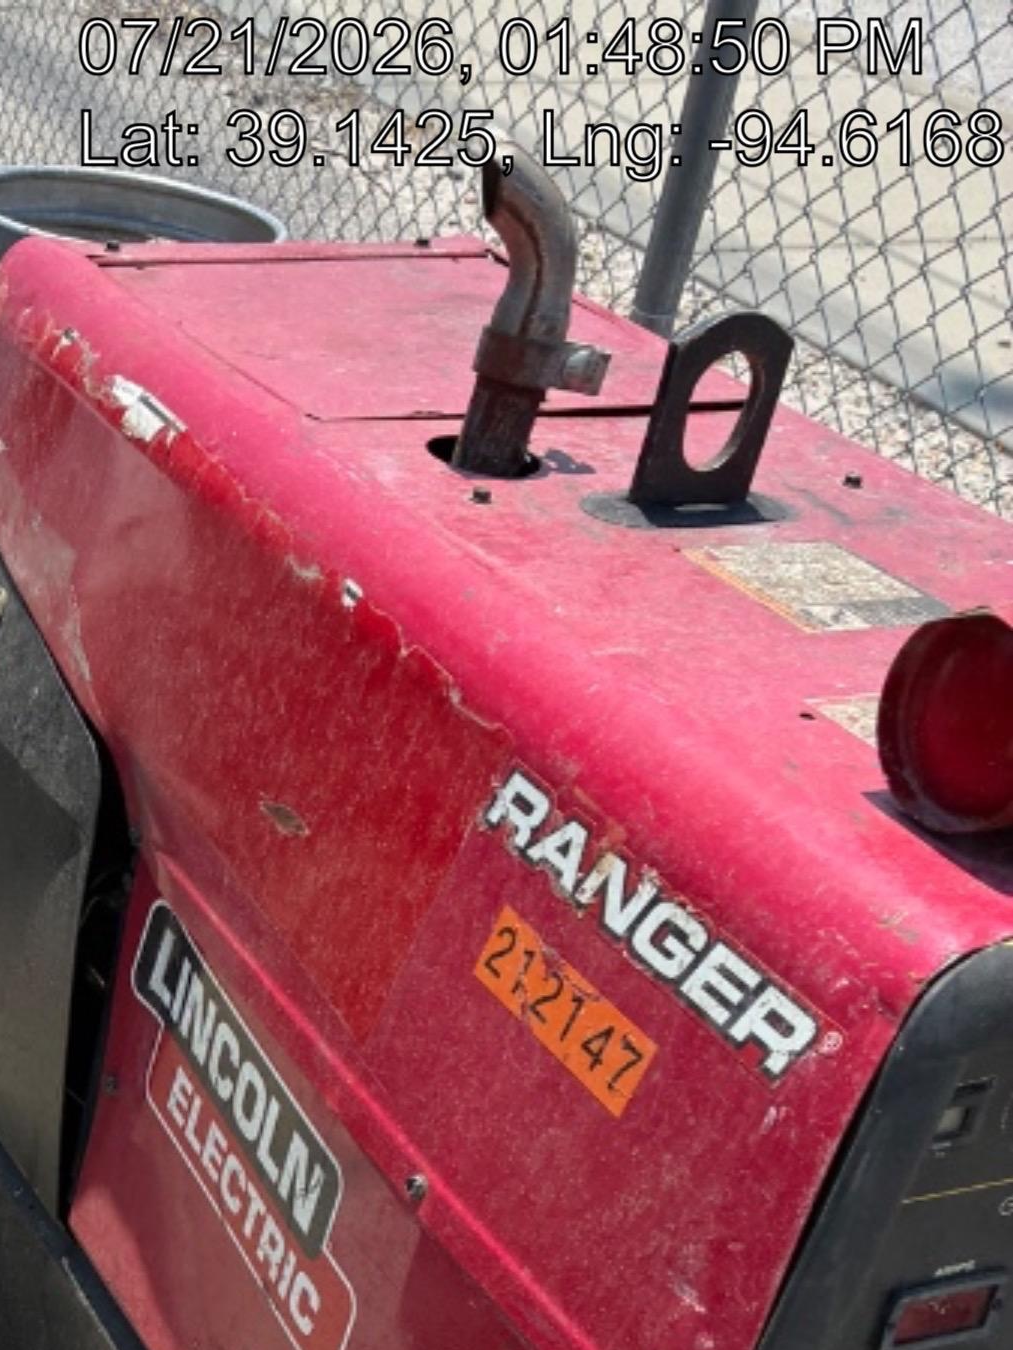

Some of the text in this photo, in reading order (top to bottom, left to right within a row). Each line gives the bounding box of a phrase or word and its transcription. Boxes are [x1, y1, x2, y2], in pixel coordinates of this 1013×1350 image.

[147, 928, 323, 1237] LINCOLN
[485, 927, 644, 1090] 212147
[168, 1068, 321, 1336] ELECTRIC
